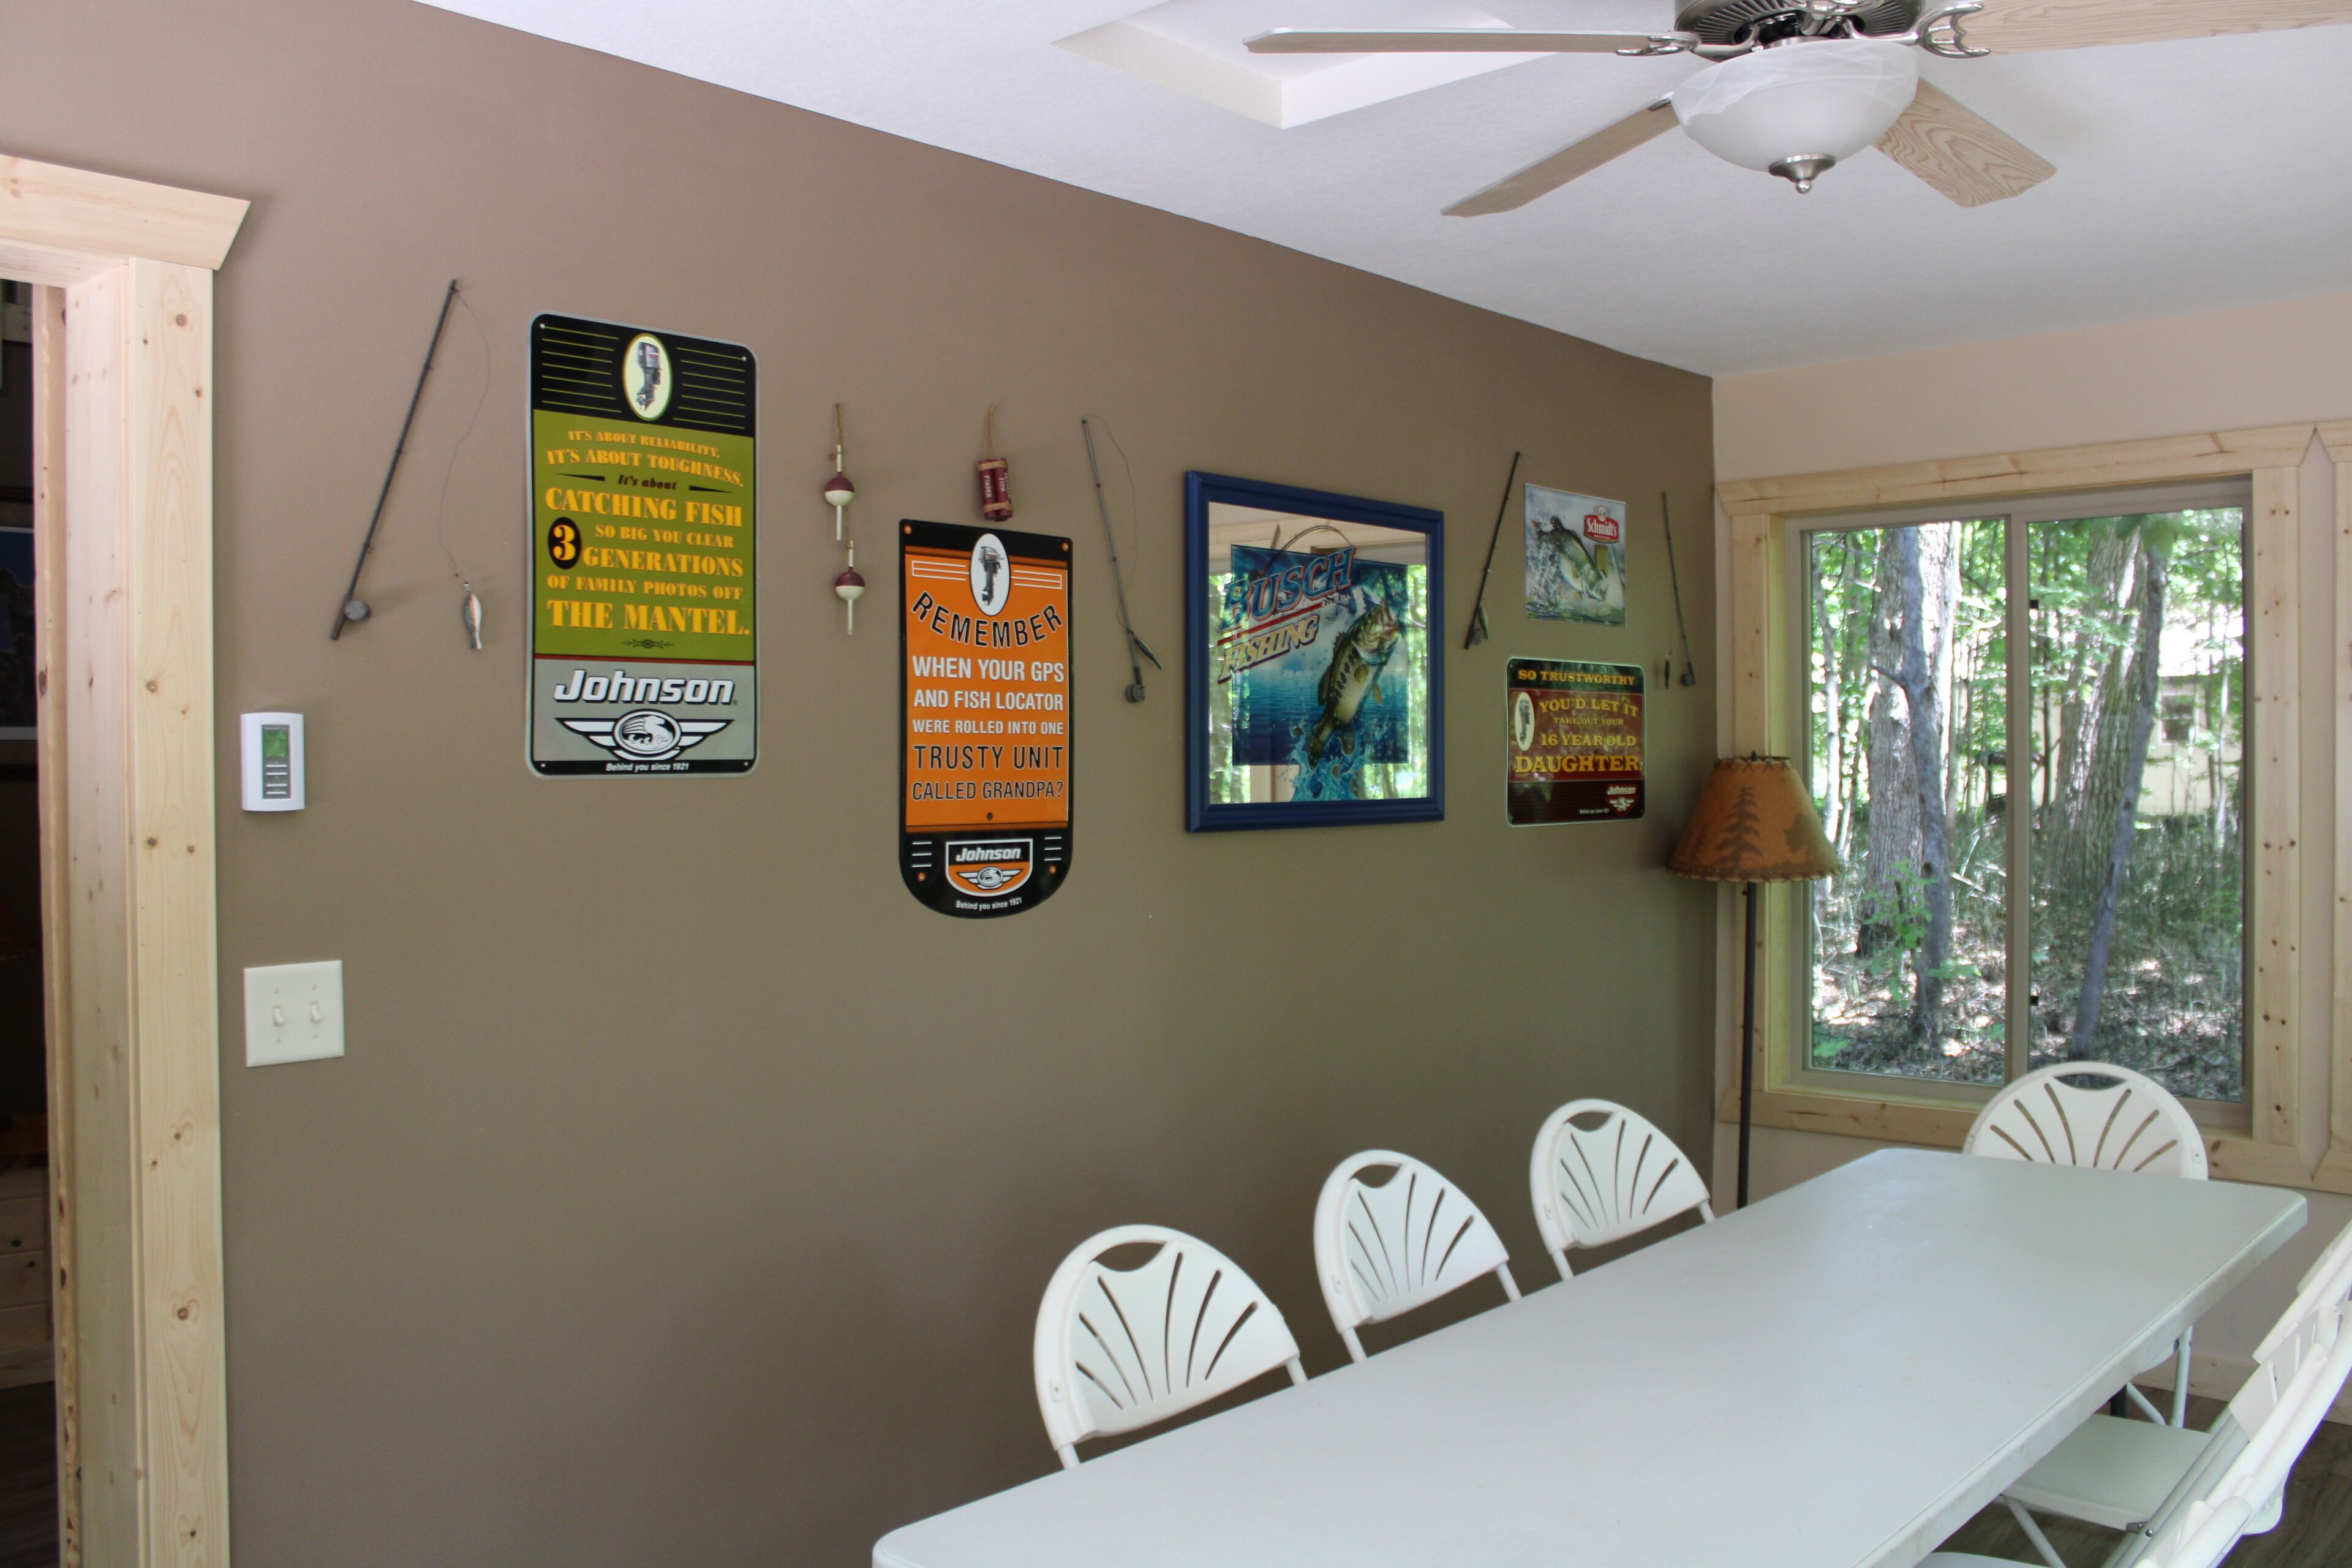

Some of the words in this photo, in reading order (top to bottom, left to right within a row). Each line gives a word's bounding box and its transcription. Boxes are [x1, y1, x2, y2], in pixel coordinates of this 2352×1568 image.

[568, 431, 592, 441] IT'S
[596, 431, 637, 444] ABOUT
[641, 435, 720, 458] RELIABILITY.
[546, 448, 580, 465] IT'S
[586, 450, 641, 467] ABOUT
[647, 454, 744, 487] TOUGHNESS.
[617, 474, 638, 486] It's
[641, 478, 677, 490] about
[545, 488, 676, 521] CATCHING
[685, 502, 743, 527] FISH
[595, 524, 615, 538] SO
[620, 527, 647, 541] BIG
[653, 529, 682, 544] YOU
[686, 532, 734, 548] CLEAR
[1587, 519, 1618, 537] Schmidt's
[552, 525, 576, 560] 3
[583, 547, 744, 577] GENERATIONS
[547, 575, 570, 589] OF
[576, 577, 637, 593] FAMILY
[644, 581, 707, 598] PHOTOS
[712, 586, 743, 600] OFF
[1218, 546, 1357, 634] BUSCH
[547, 600, 612, 628] THE
[623, 605, 750, 635] MANTEL.
[912, 591, 1062, 648] REMEMBER
[1217, 614, 1319, 685] FISHING
[912, 656, 971, 679] WHEN
[978, 659, 1025, 681] YOUR
[1031, 662, 1065, 682] GPS
[1518, 669, 1537, 680] SO
[1541, 671, 1635, 686] TRUSTWORTHY
[554, 669, 735, 704] Johnson
[913, 690, 949, 707] AND
[954, 691, 990, 709] FISH
[996, 692, 1063, 711] LOCATOR
[1539, 698, 1586, 714] YOU'D
[1591, 699, 1620, 712] LET
[1624, 704, 1639, 717] IT
[913, 720, 950, 733] WERE
[955, 720, 1003, 734] ROLLED
[1008, 722, 1036, 734] INTO
[1041, 722, 1063, 735] ONE
[1540, 734, 1558, 746] 16
[1561, 734, 1602, 746] YEAR
[1605, 735, 1637, 747] OLD
[913, 745, 1004, 770] TRUSTY
[1014, 745, 1064, 770] UNIT
[912, 782, 976, 801] CALLED
[982, 781, 1063, 800] GRANDPA?
[1607, 786, 1636, 796] Johnson
[956, 847, 1021, 861] Johnson
[956, 900, 978, 910] Behind
[979, 903, 990, 911] you
[992, 900, 1008, 909] since
[1009, 897, 1022, 906] 1921
